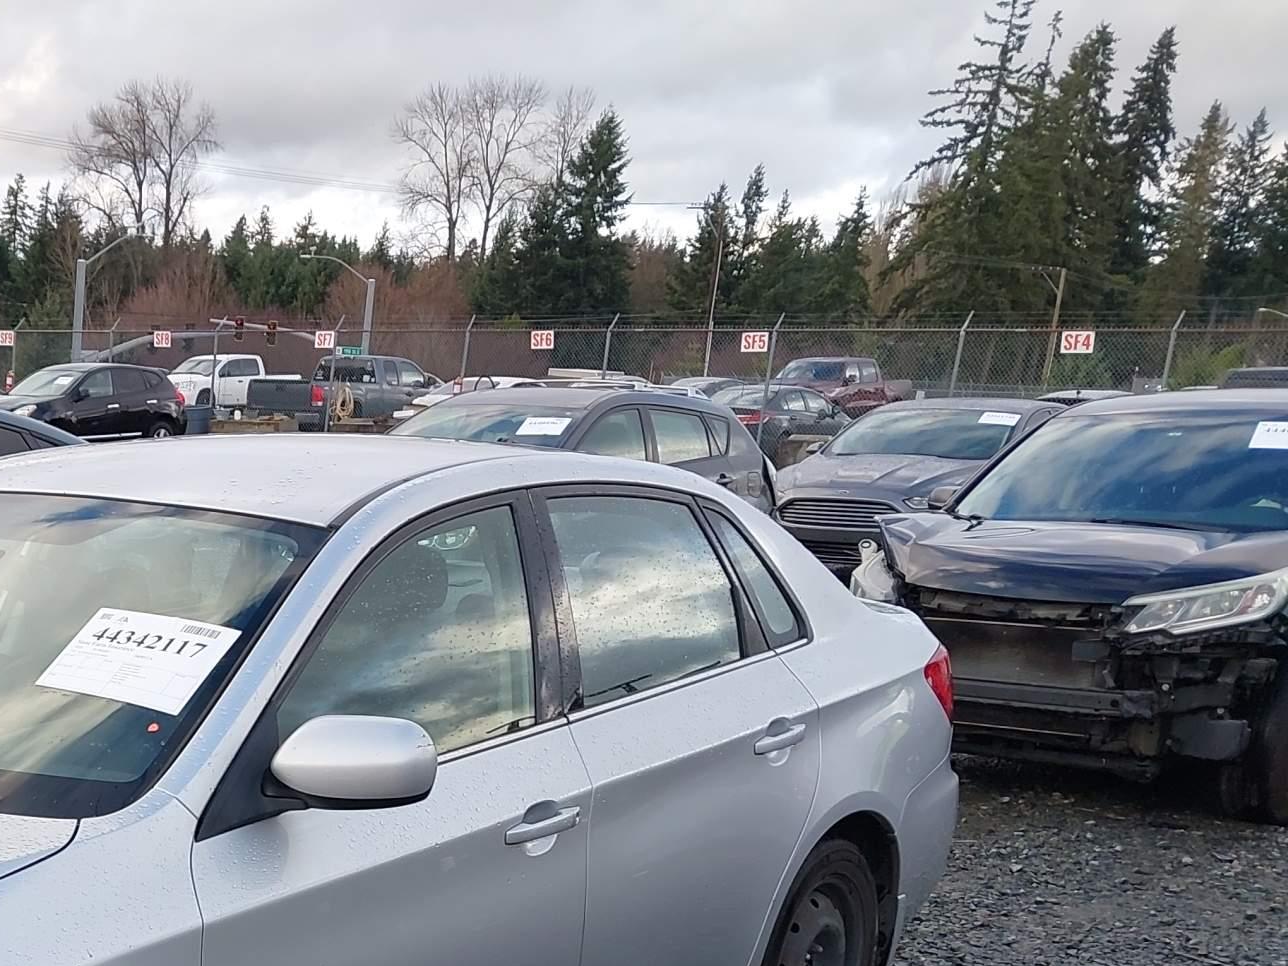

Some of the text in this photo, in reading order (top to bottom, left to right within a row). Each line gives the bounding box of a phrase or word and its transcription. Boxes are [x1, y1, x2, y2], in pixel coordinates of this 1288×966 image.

[0, 332, 13, 344] SF9
[155, 333, 170, 346] SF8
[317, 333, 333, 346] SF7
[533, 333, 552, 347] SF6
[743, 334, 766, 350] SF5
[1063, 334, 1091, 351] SF4
[93, 627, 208, 658] 44342117
